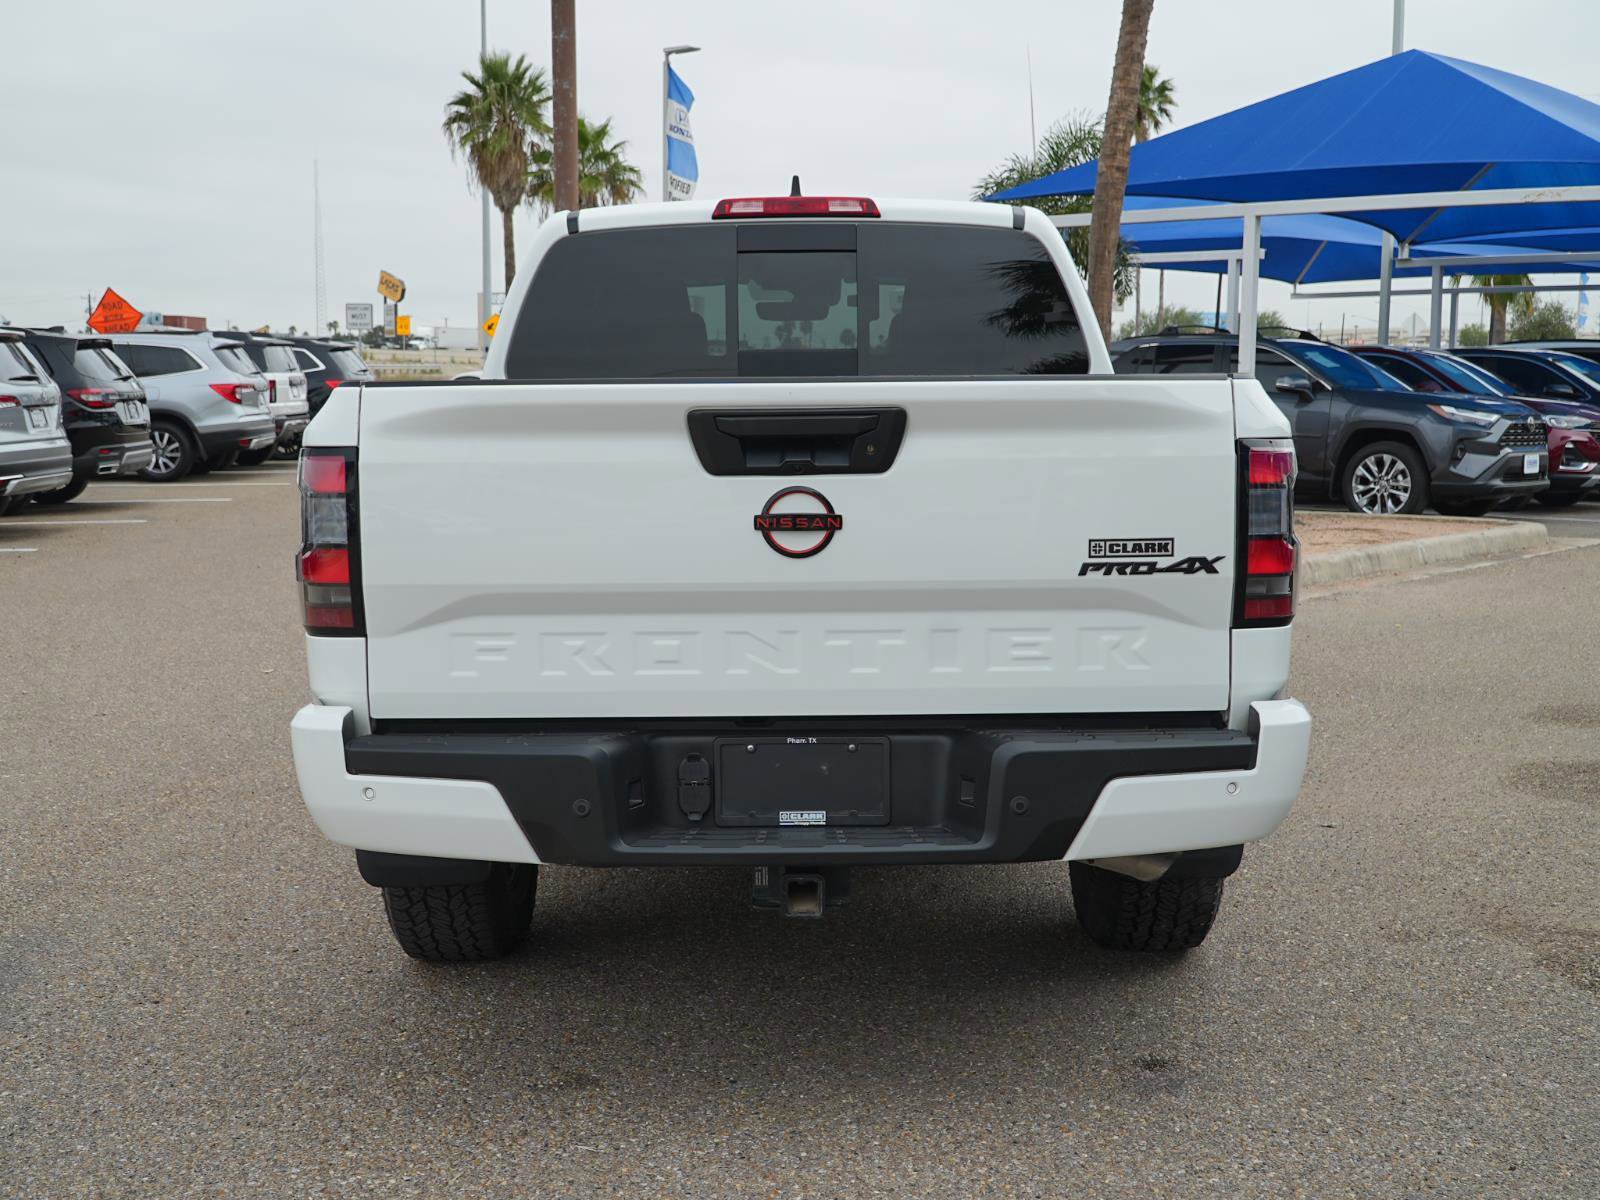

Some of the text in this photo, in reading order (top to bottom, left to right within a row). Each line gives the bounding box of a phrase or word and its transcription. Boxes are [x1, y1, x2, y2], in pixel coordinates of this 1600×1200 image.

[102, 301, 123, 312] ROAD
[104, 323, 131, 332] AHEAD
[756, 517, 841, 529] NISSAN
[1108, 542, 1171, 554] CLARK
[449, 627, 1151, 676] FRONTIER
